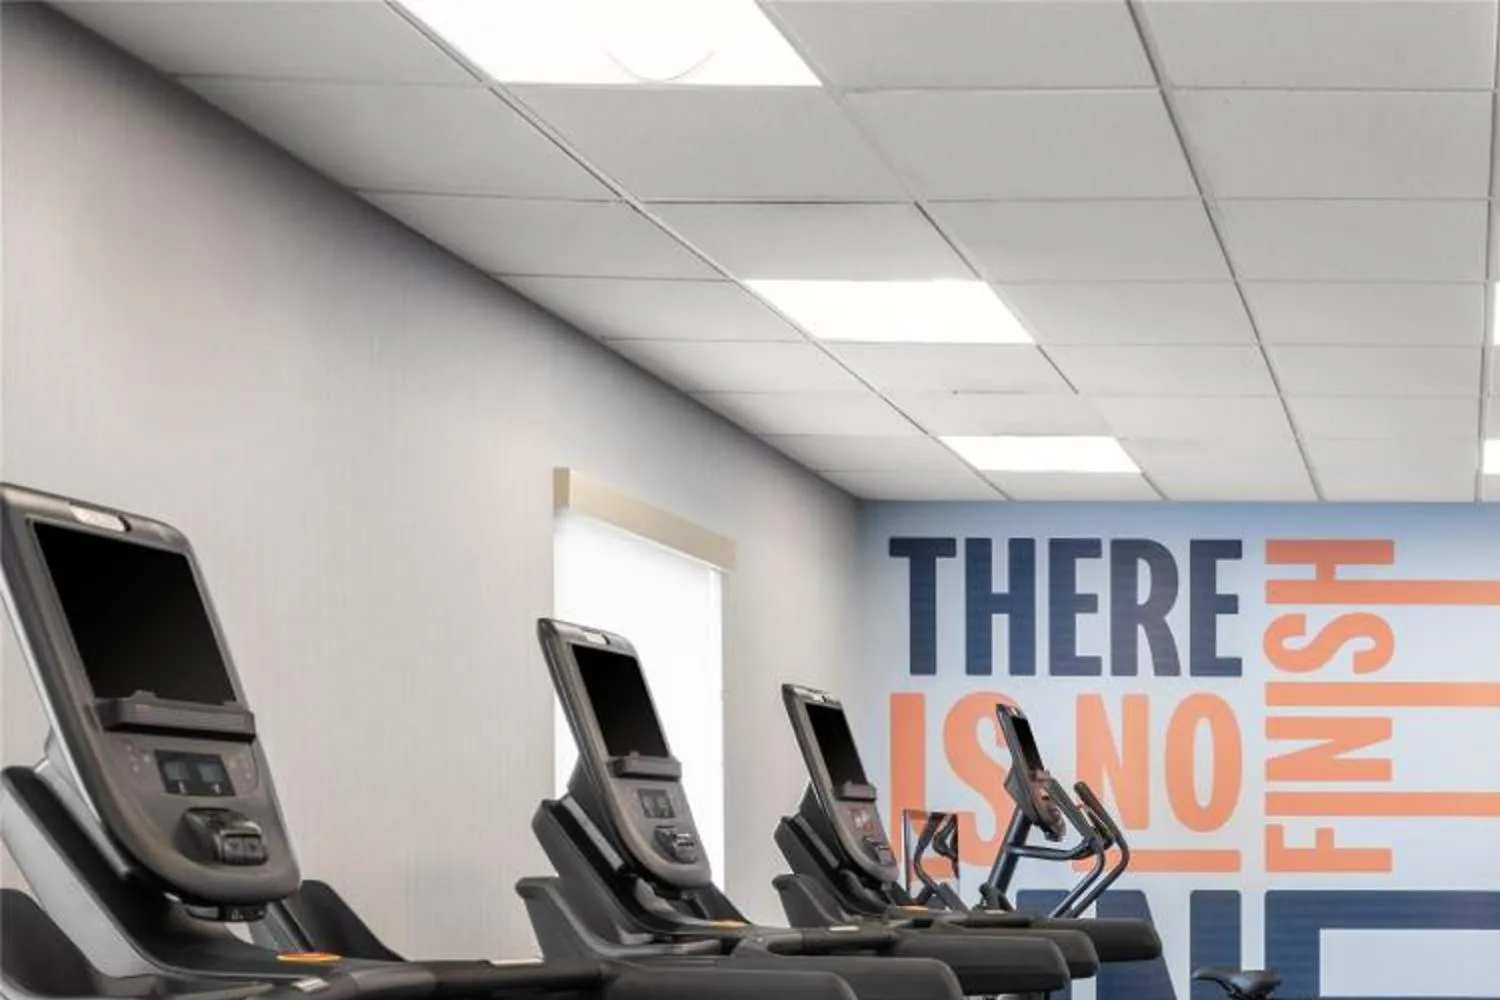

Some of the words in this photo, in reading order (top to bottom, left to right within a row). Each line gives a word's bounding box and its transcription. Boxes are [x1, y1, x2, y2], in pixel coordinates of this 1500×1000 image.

[889, 538, 1243, 677] THERE
[889, 691, 1016, 878] IS
[1075, 692, 1243, 832] NO
[1263, 539, 1396, 873] FINISH
